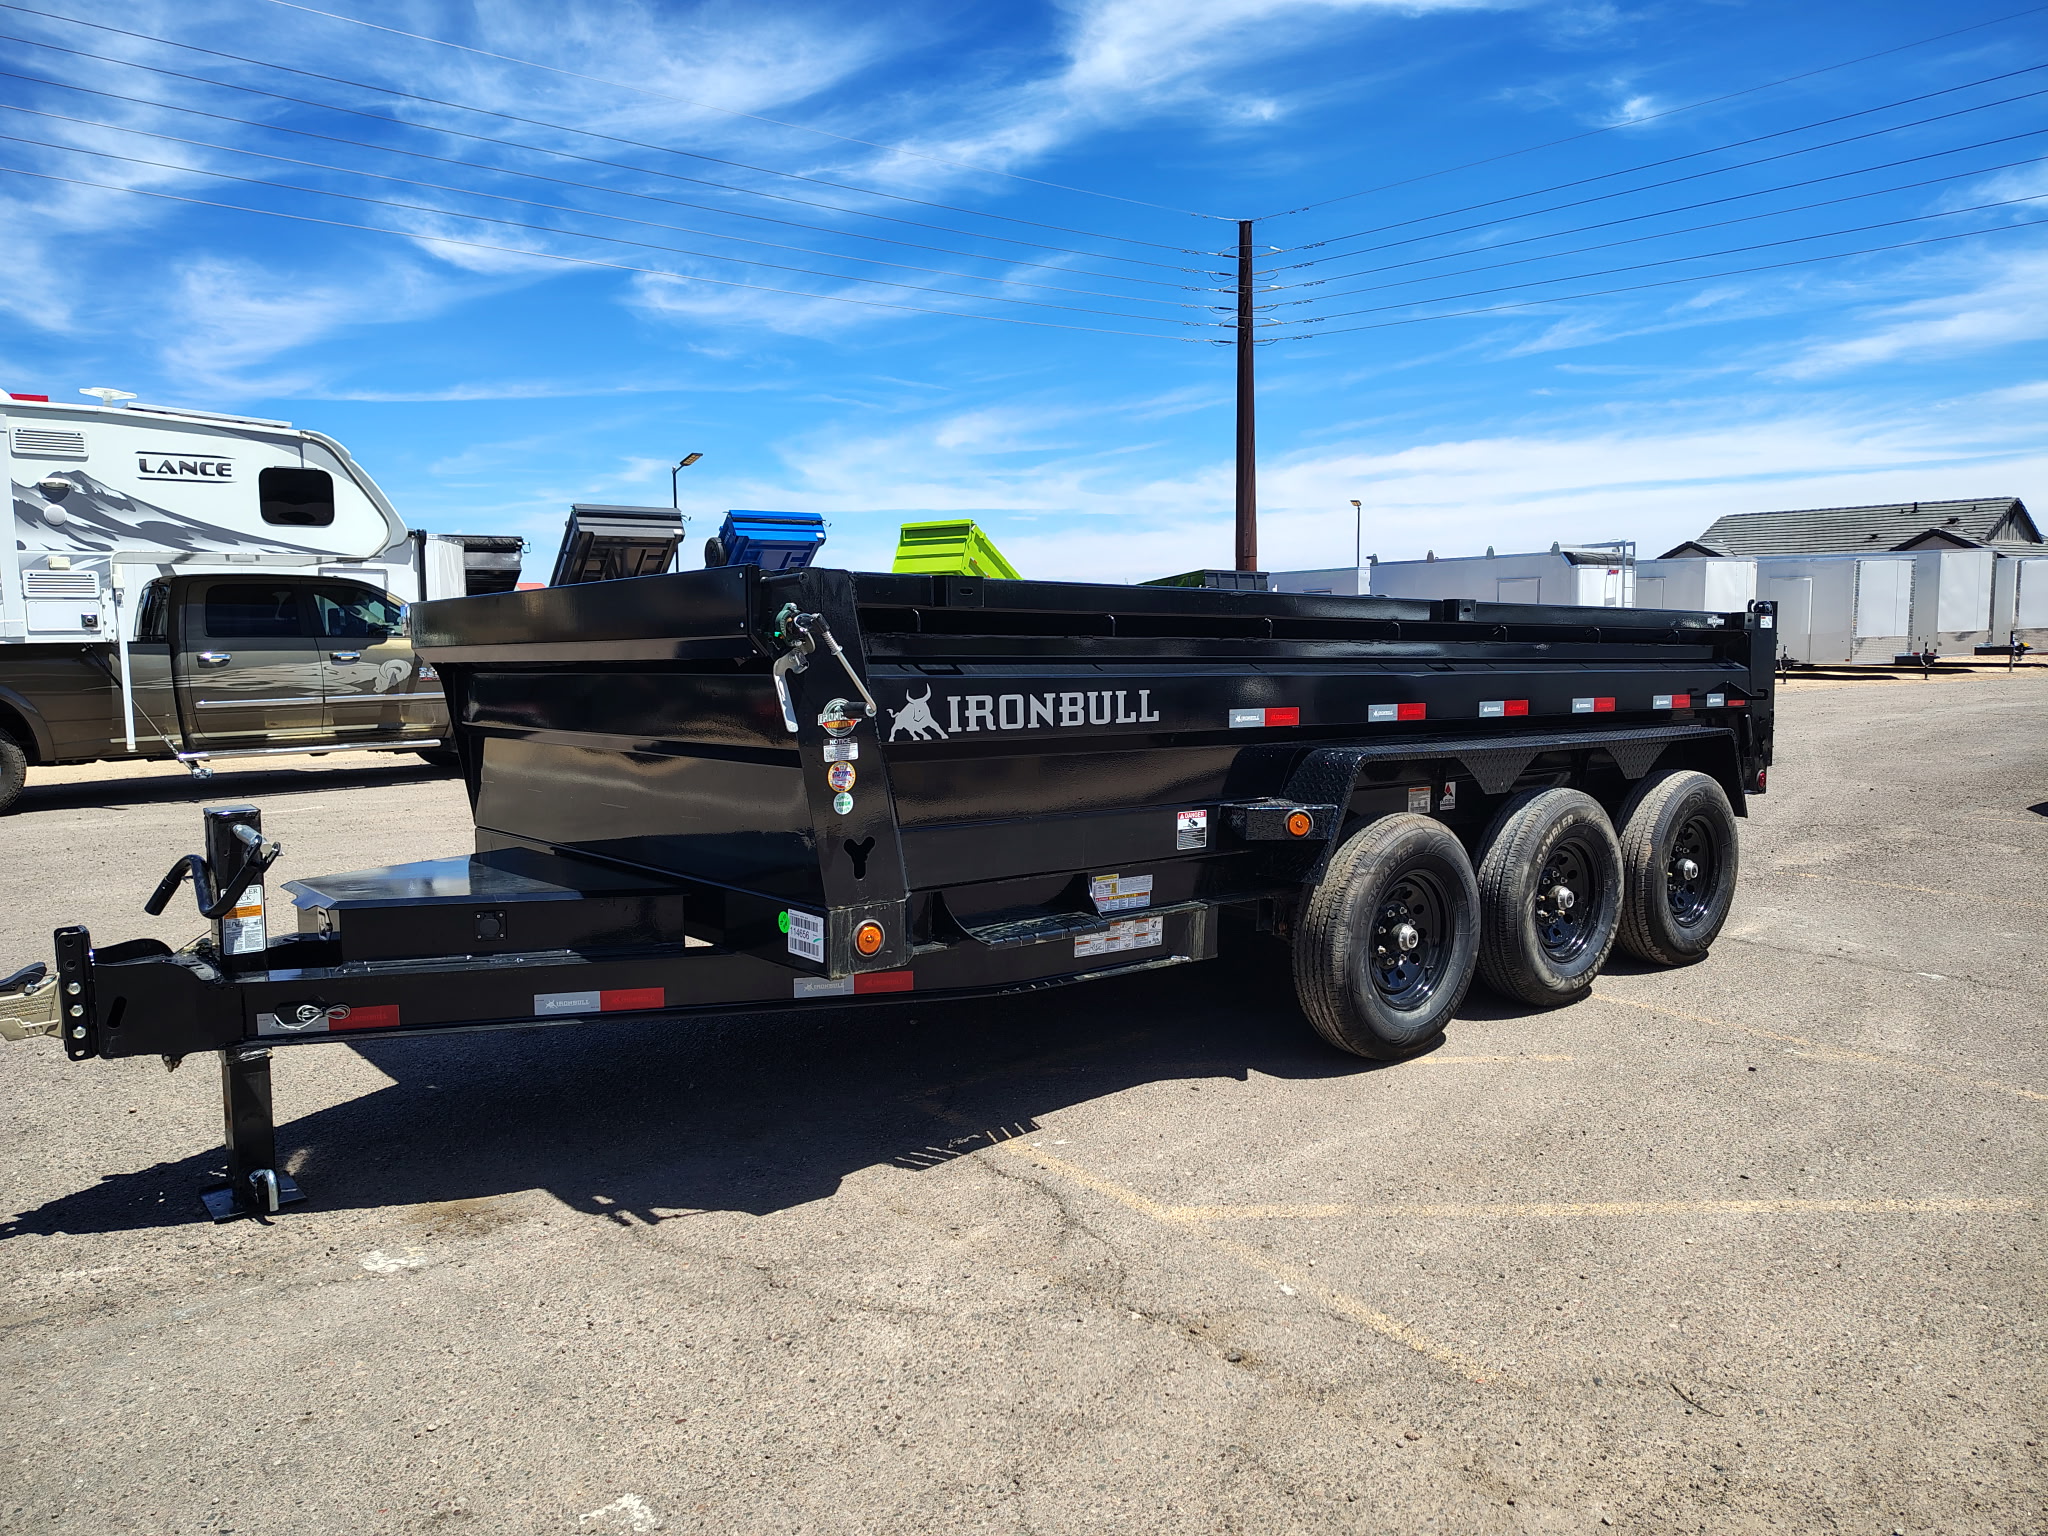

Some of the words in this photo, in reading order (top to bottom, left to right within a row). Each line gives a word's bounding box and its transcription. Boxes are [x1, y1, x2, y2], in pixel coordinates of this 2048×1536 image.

[139, 458, 232, 477] LANCE
[947, 689, 1160, 733] IRONBULL
[829, 737, 852, 745] NOTICE
[1184, 811, 1205, 819] DANGER
[1536, 813, 1574, 866] RAMBLER
[1571, 922, 1619, 989] TASKMASTER
[555, 998, 591, 1008] IRONBULL
